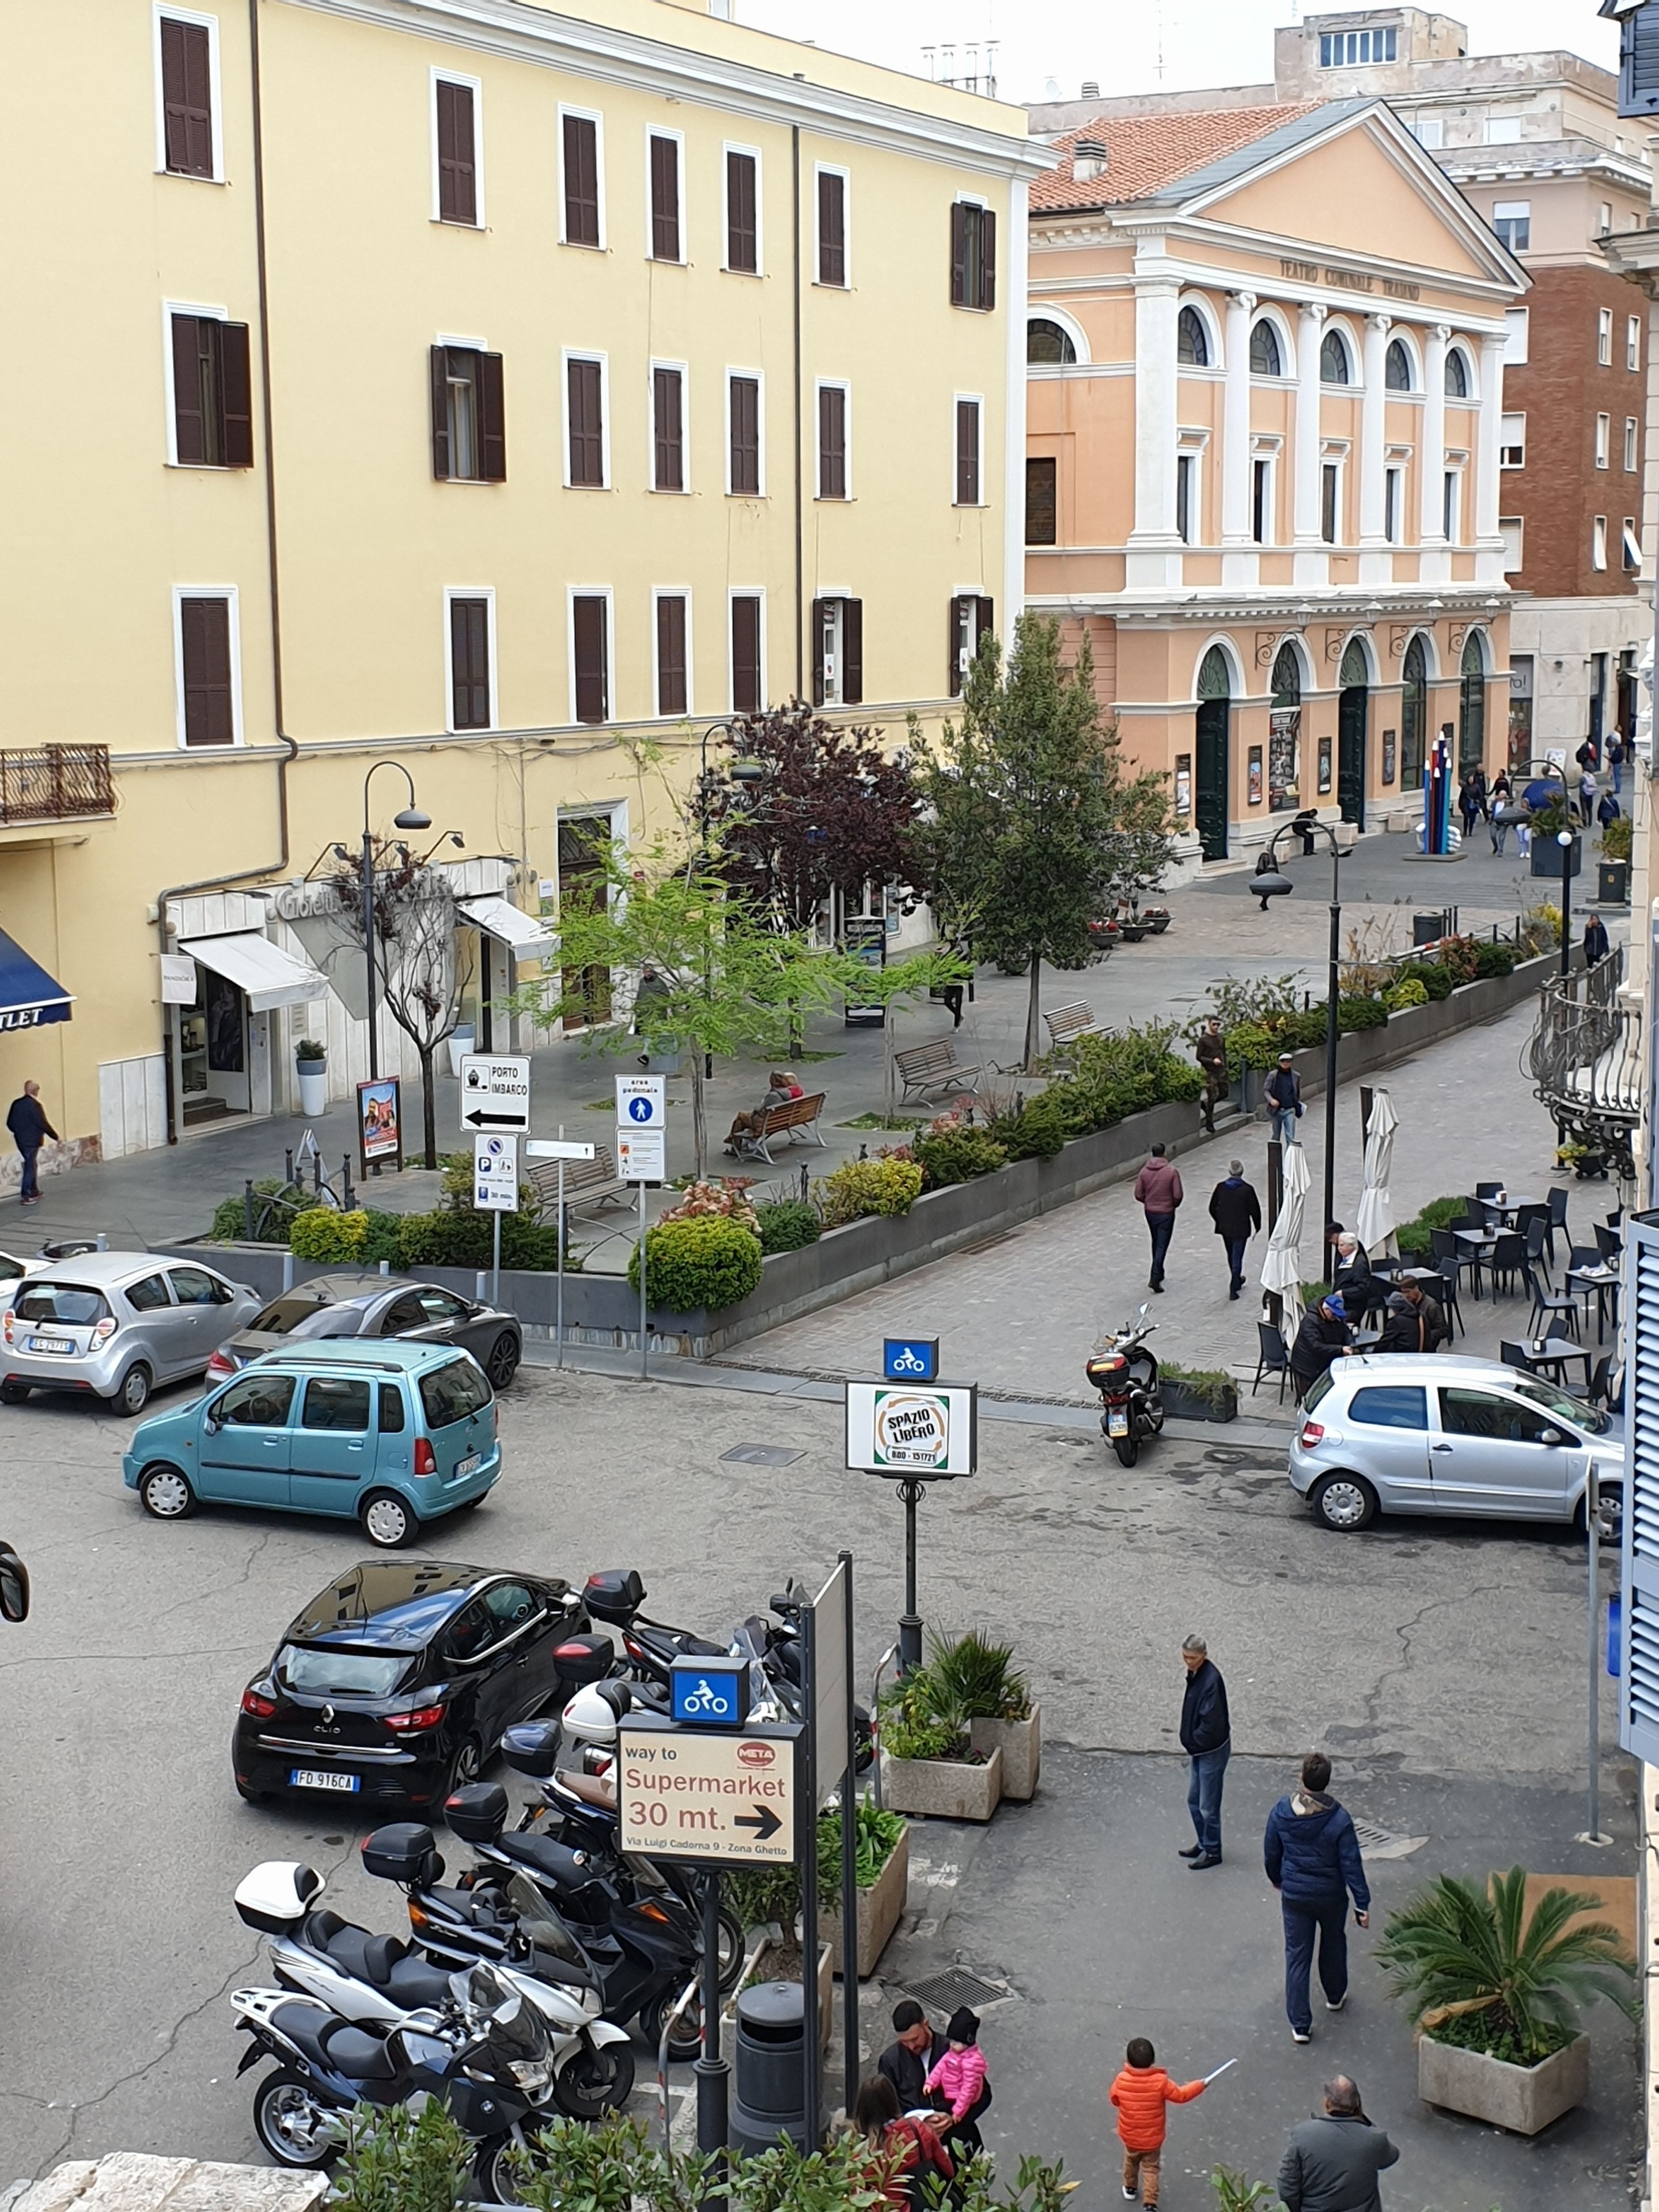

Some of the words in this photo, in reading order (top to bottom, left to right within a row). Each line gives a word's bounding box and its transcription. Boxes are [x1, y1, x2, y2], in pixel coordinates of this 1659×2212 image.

[1279, 259, 1318, 283] TEATRO
[492, 1066, 518, 1078] PORTO
[492, 1084, 528, 1096] IMBARCO
[888, 1408, 930, 1429] SPAZIO
[893, 1423, 935, 1444] LIBERO
[313, 1725, 342, 1734] CLIO
[625, 1747, 657, 1763] way
[662, 1747, 677, 1760] to
[738, 1747, 774, 1759] META
[299, 1771, 313, 1786] FD
[318, 1774, 351, 1789] 916CA
[626, 1768, 785, 1798] Supermarket
[628, 1801, 668, 1827] 30
[679, 1806, 726, 1831] mt.
[626, 1836, 642, 1846] Via
[645, 1837, 667, 1849] Luigi
[670, 1839, 710, 1850] Cadorna
[713, 1842, 720, 1851] 9
[728, 1843, 752, 1853] Zona
[755, 1844, 787, 1855] Ghetto
